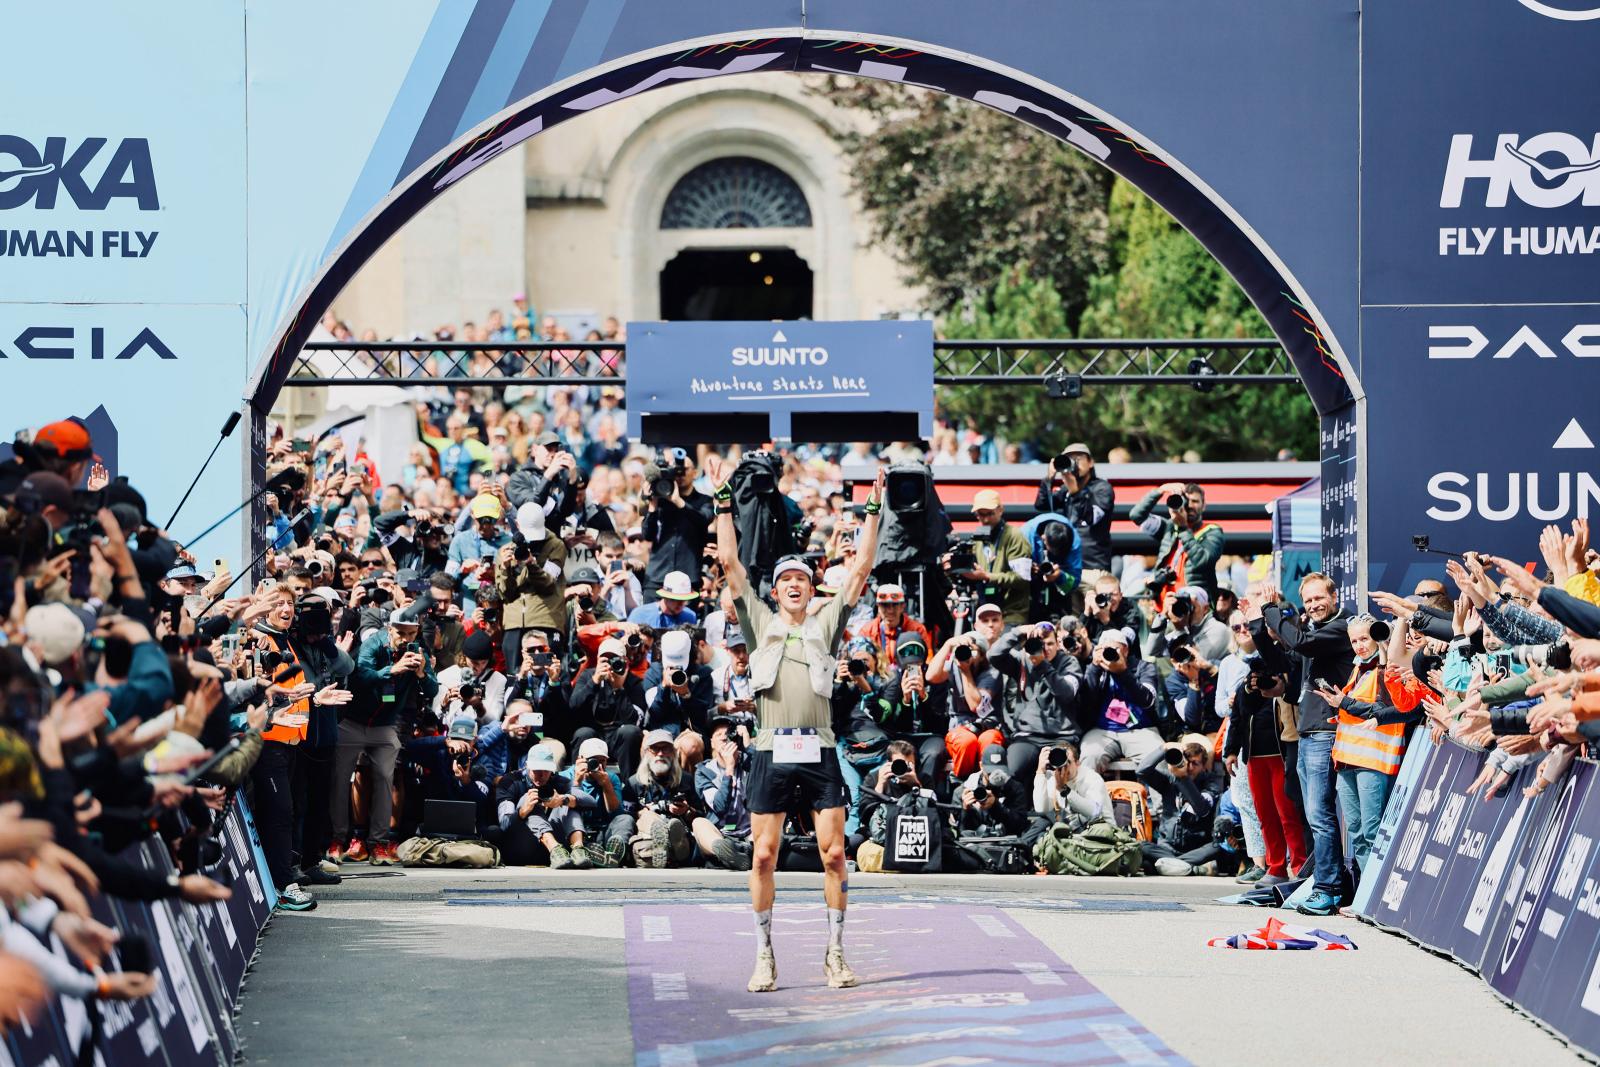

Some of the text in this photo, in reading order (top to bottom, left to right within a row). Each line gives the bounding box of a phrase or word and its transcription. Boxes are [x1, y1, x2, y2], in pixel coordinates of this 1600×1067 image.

[1439, 132, 1600, 208] HO
[102, 231, 159, 257] FLY
[1439, 227, 1497, 255] FLY
[0, 327, 178, 359] CIA
[732, 347, 829, 366] SUUNTO
[901, 822, 925, 833] THE
[900, 833, 926, 845] ADV
[898, 845, 926, 856] BKY
